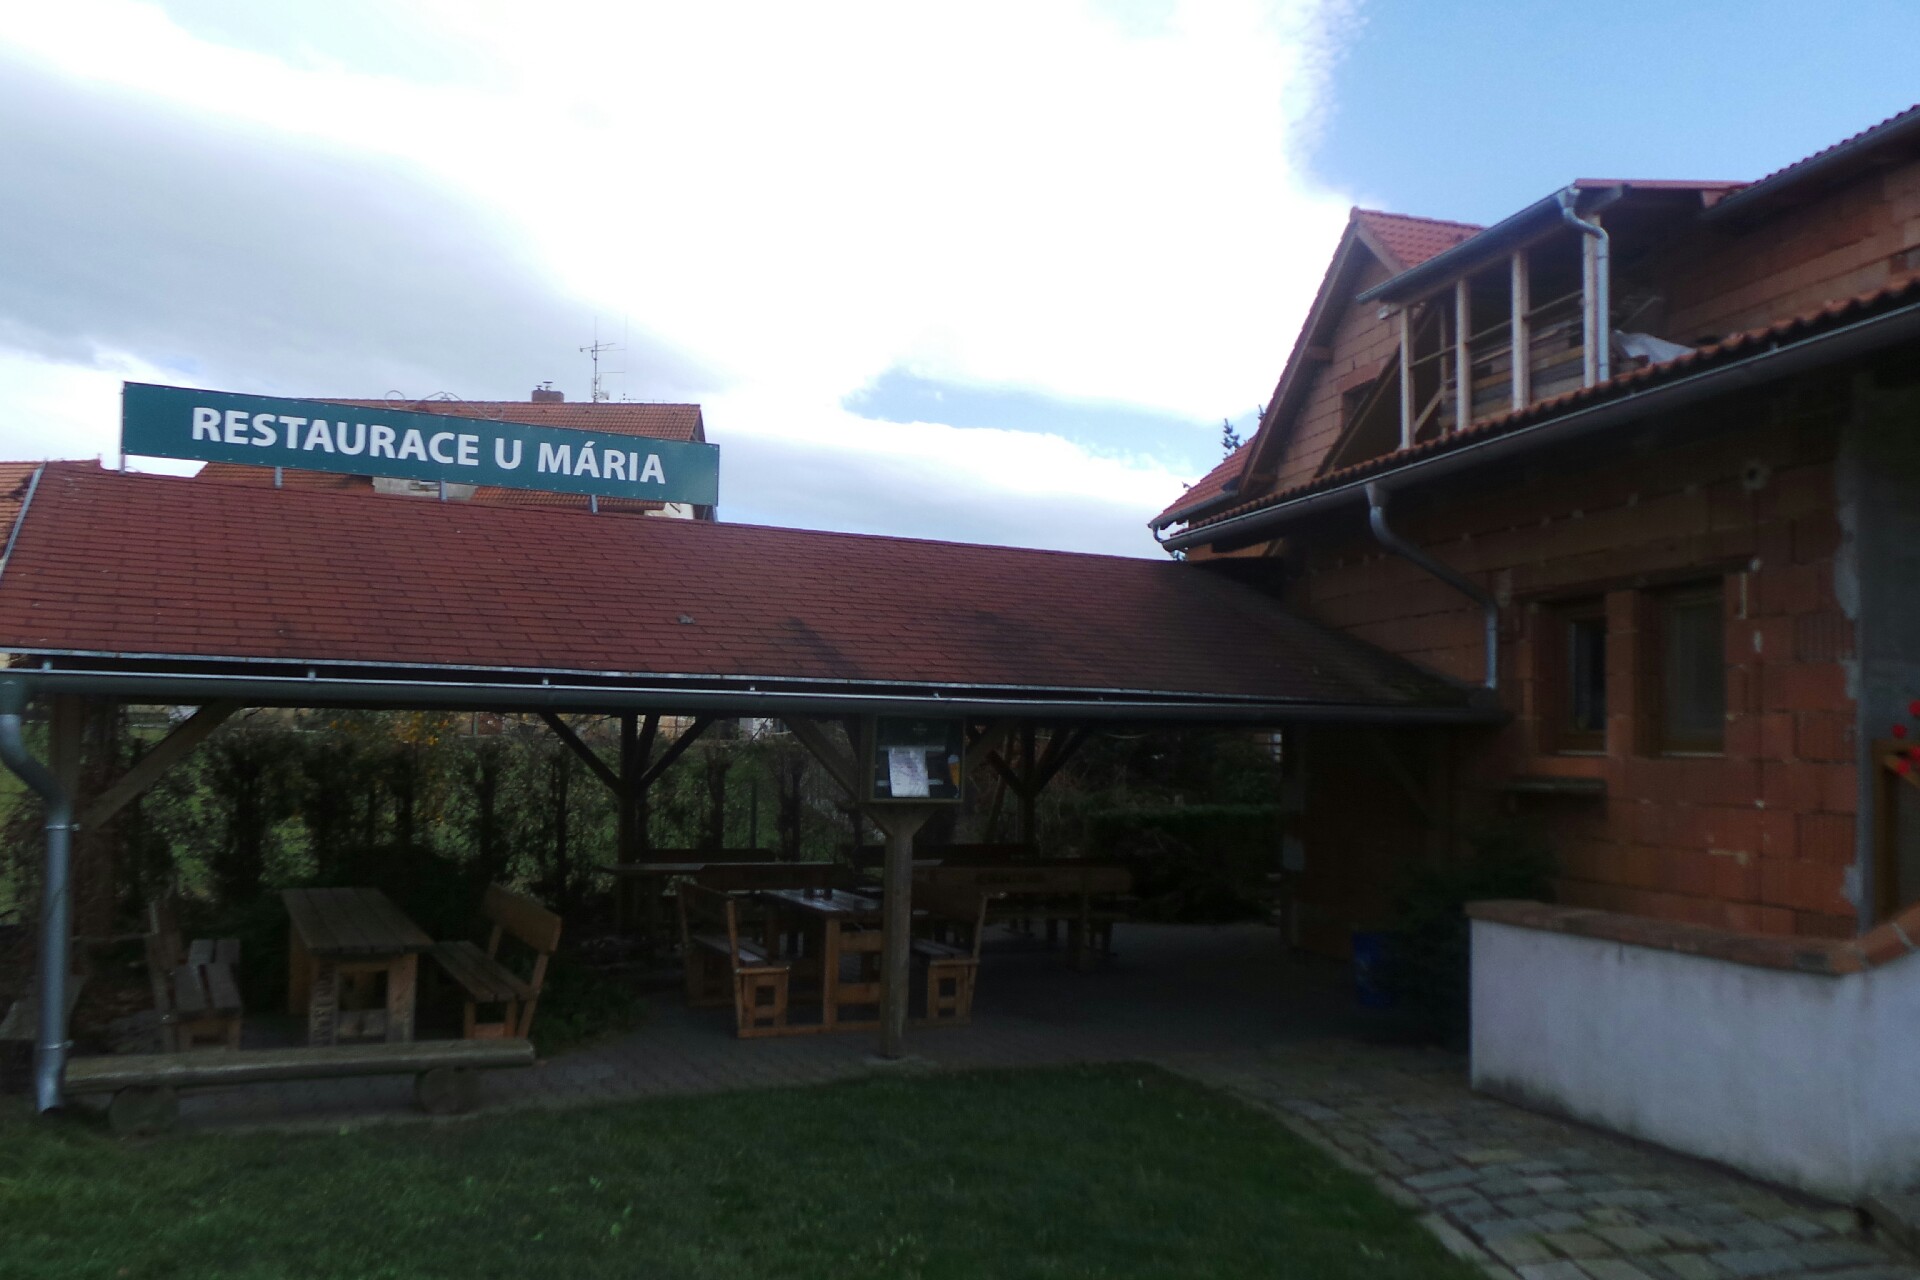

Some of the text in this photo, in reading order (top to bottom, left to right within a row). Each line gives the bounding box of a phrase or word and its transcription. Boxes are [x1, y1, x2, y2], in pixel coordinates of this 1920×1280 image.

[193, 407, 666, 484] RESTAURACE U MÁRIA
